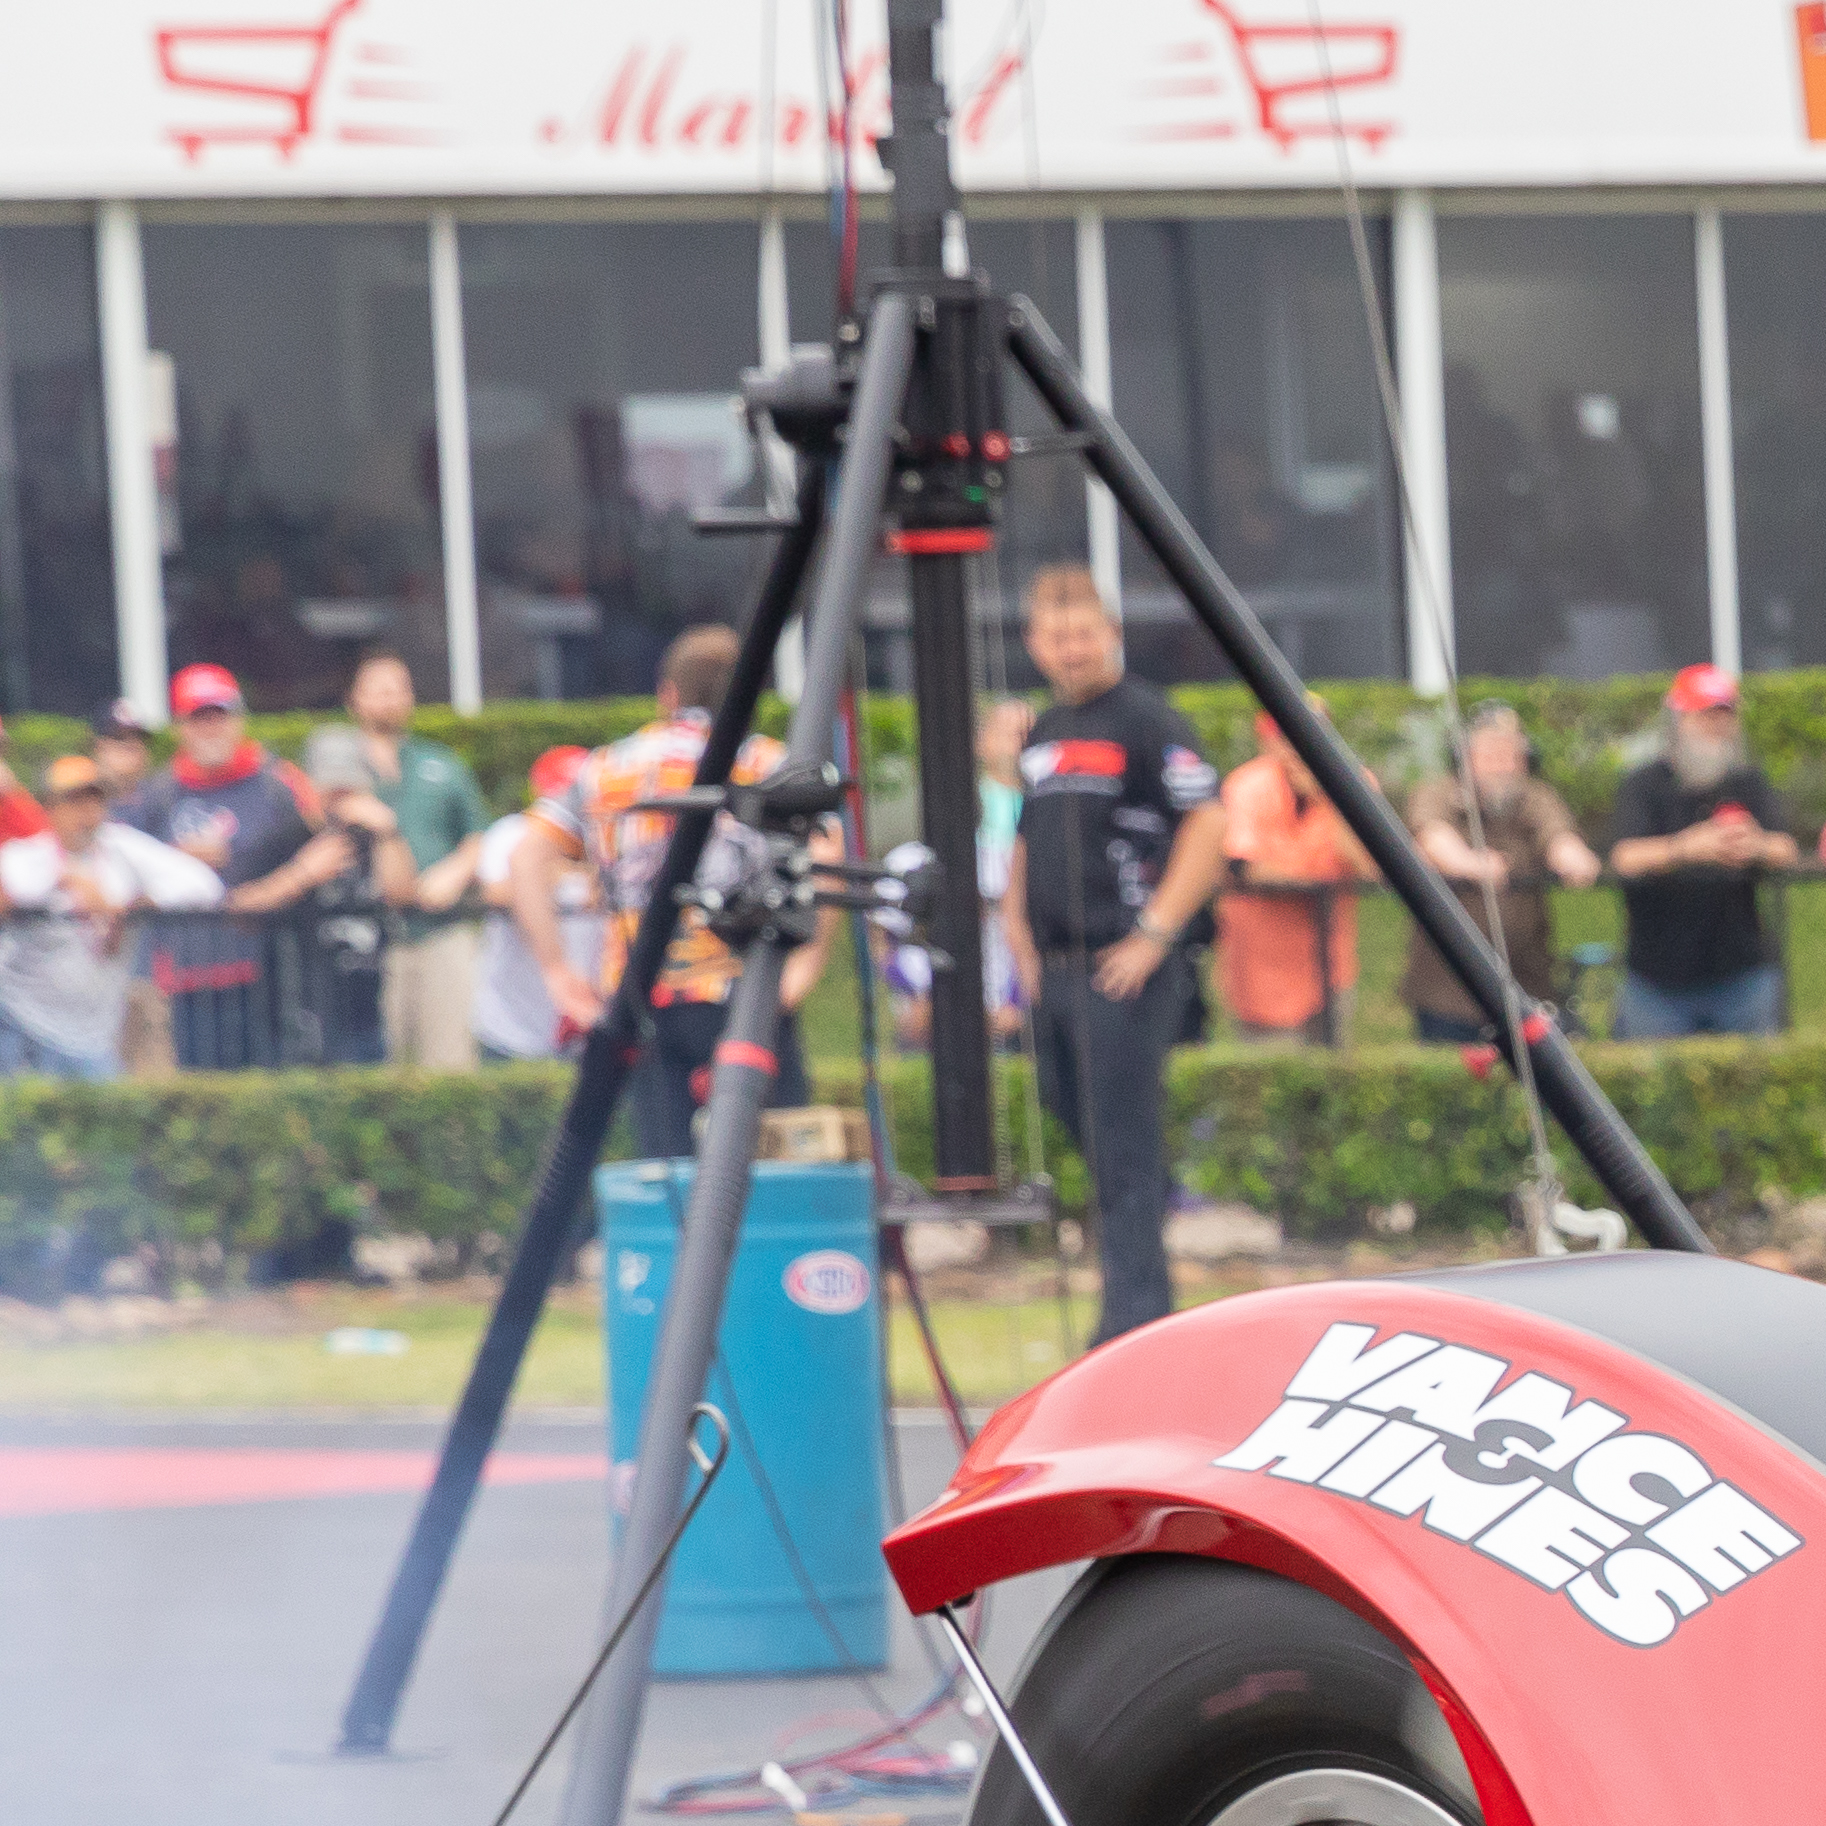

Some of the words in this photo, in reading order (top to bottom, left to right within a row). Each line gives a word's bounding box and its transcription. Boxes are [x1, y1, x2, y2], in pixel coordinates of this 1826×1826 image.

[535, 35, 1024, 155] Markt
[1212, 1399, 1710, 1648] HINES
[1284, 1322, 1805, 1596] VANCE
